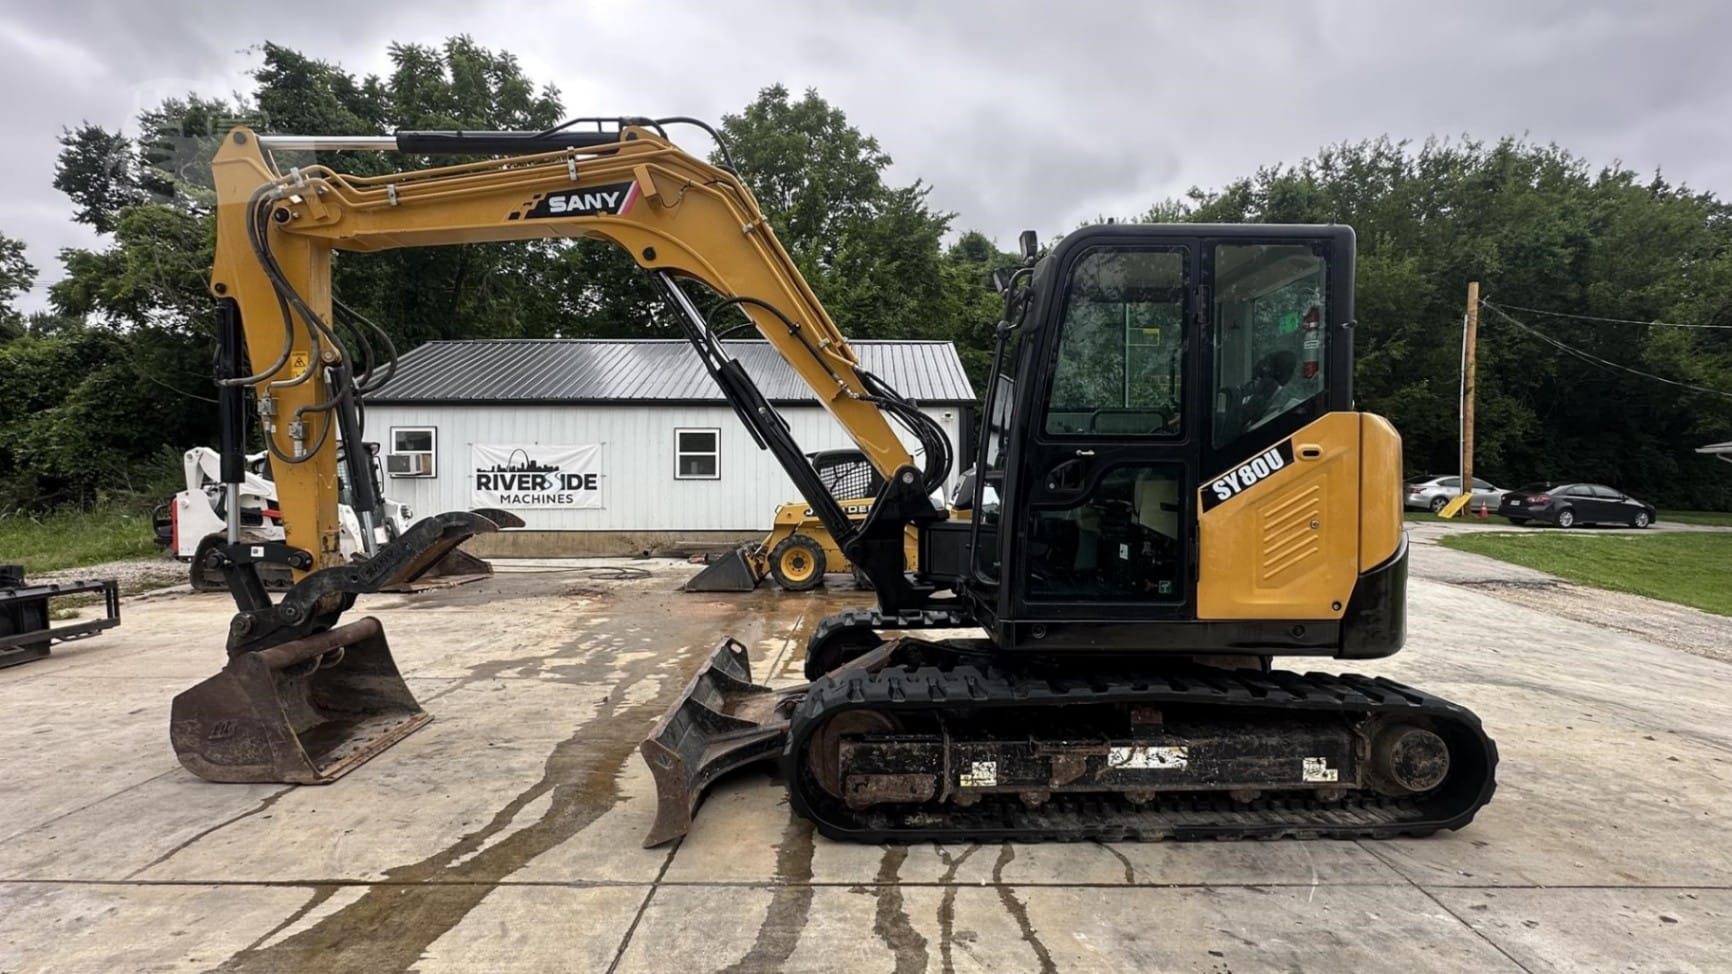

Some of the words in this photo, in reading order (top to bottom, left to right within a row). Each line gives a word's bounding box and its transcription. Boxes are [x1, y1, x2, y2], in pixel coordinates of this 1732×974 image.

[549, 192, 620, 213] SANY
[476, 473, 598, 491] RIVERSIDE
[1212, 448, 1284, 501] SY80U
[500, 494, 574, 504] MACHINES
